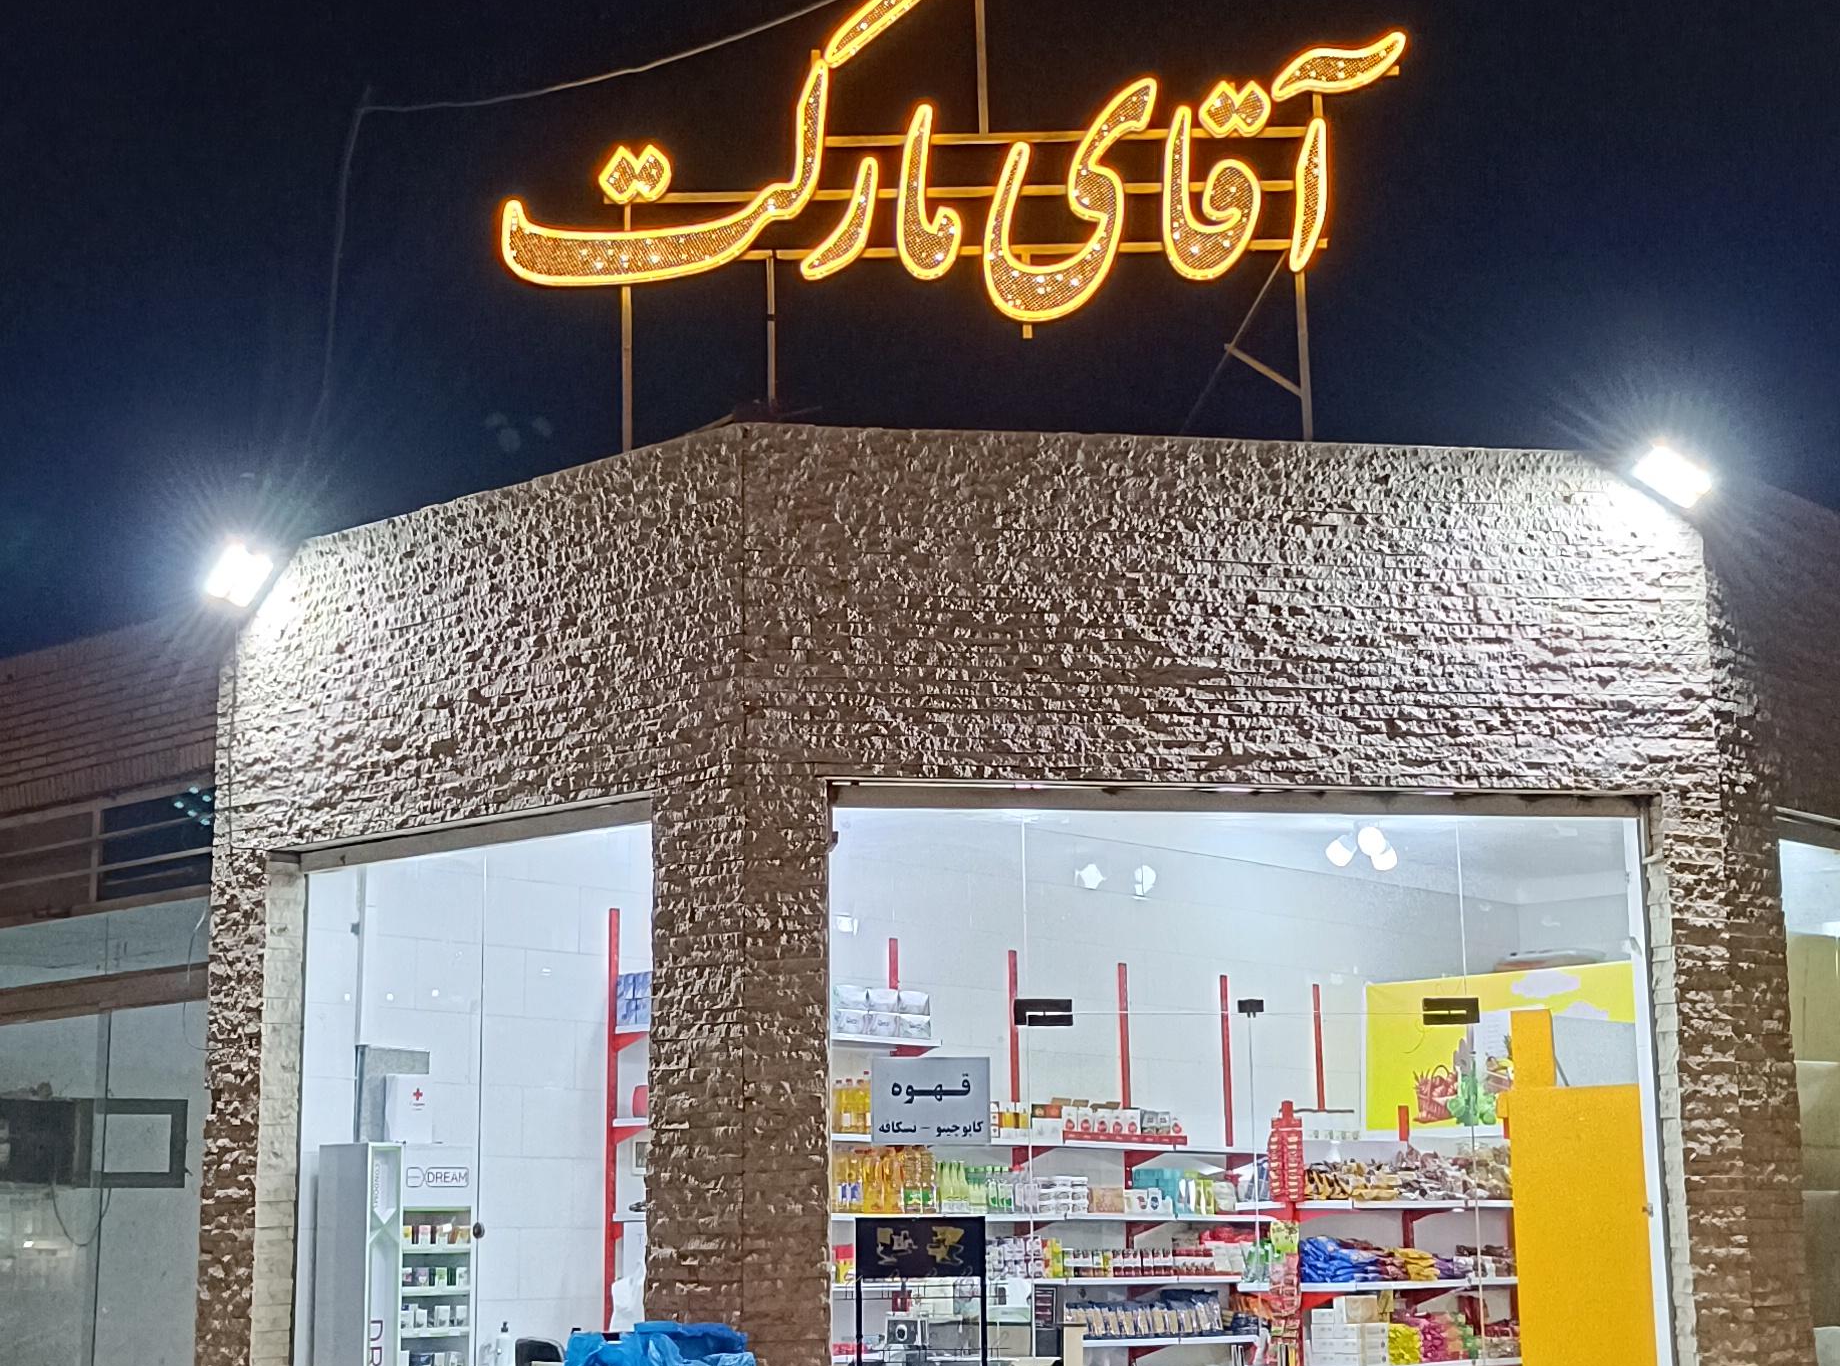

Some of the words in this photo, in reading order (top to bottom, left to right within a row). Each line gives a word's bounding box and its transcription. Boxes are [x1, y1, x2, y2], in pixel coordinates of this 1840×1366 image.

[984, 32, 1406, 322] آقای
[891, 1073, 971, 1104] قهوه
[427, 1171, 468, 1184] DREAM
